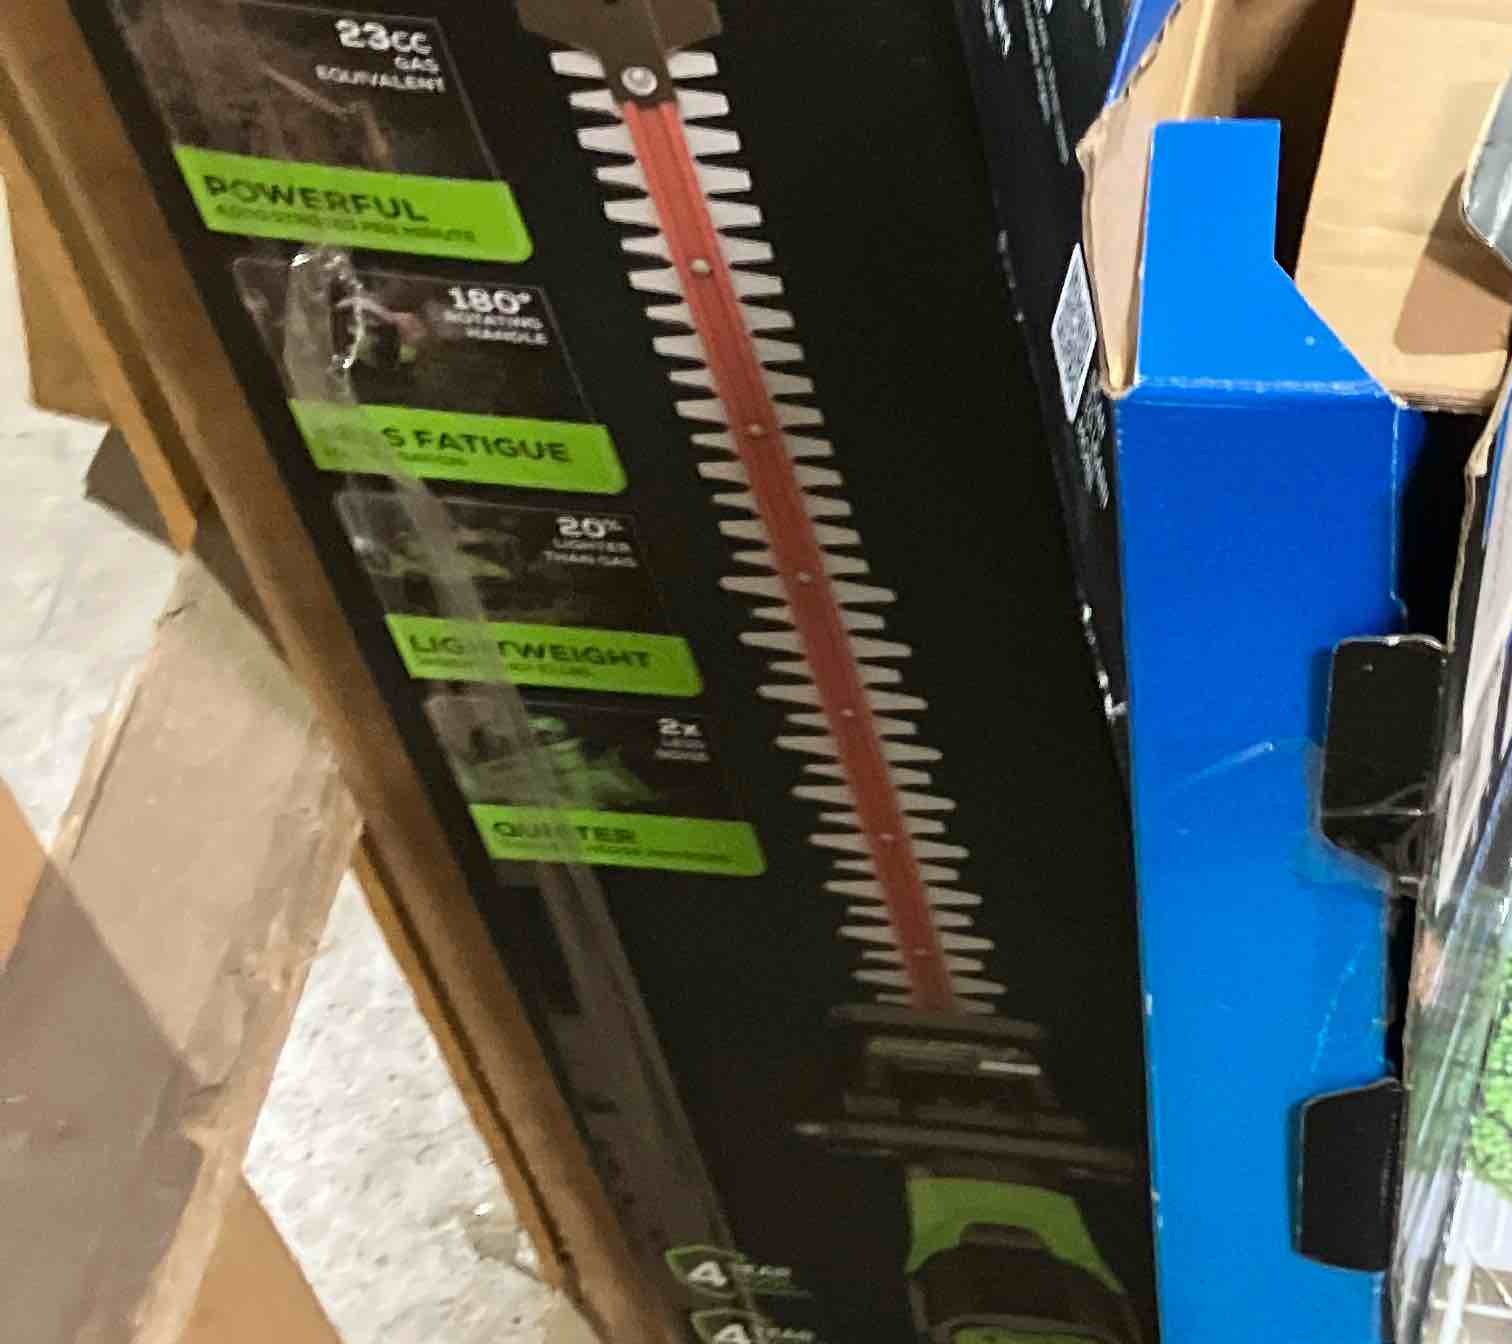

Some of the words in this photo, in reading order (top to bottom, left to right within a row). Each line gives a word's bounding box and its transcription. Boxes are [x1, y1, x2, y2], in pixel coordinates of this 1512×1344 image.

[334, 18, 434, 55] 23cc
[314, 63, 448, 93] EQUIVALENT
[203, 174, 432, 224] POWERFUL
[448, 285, 533, 317] 180°
[410, 428, 572, 465] FATIGUE
[556, 516, 624, 539] 20%
[687, 1260, 728, 1288] 4
